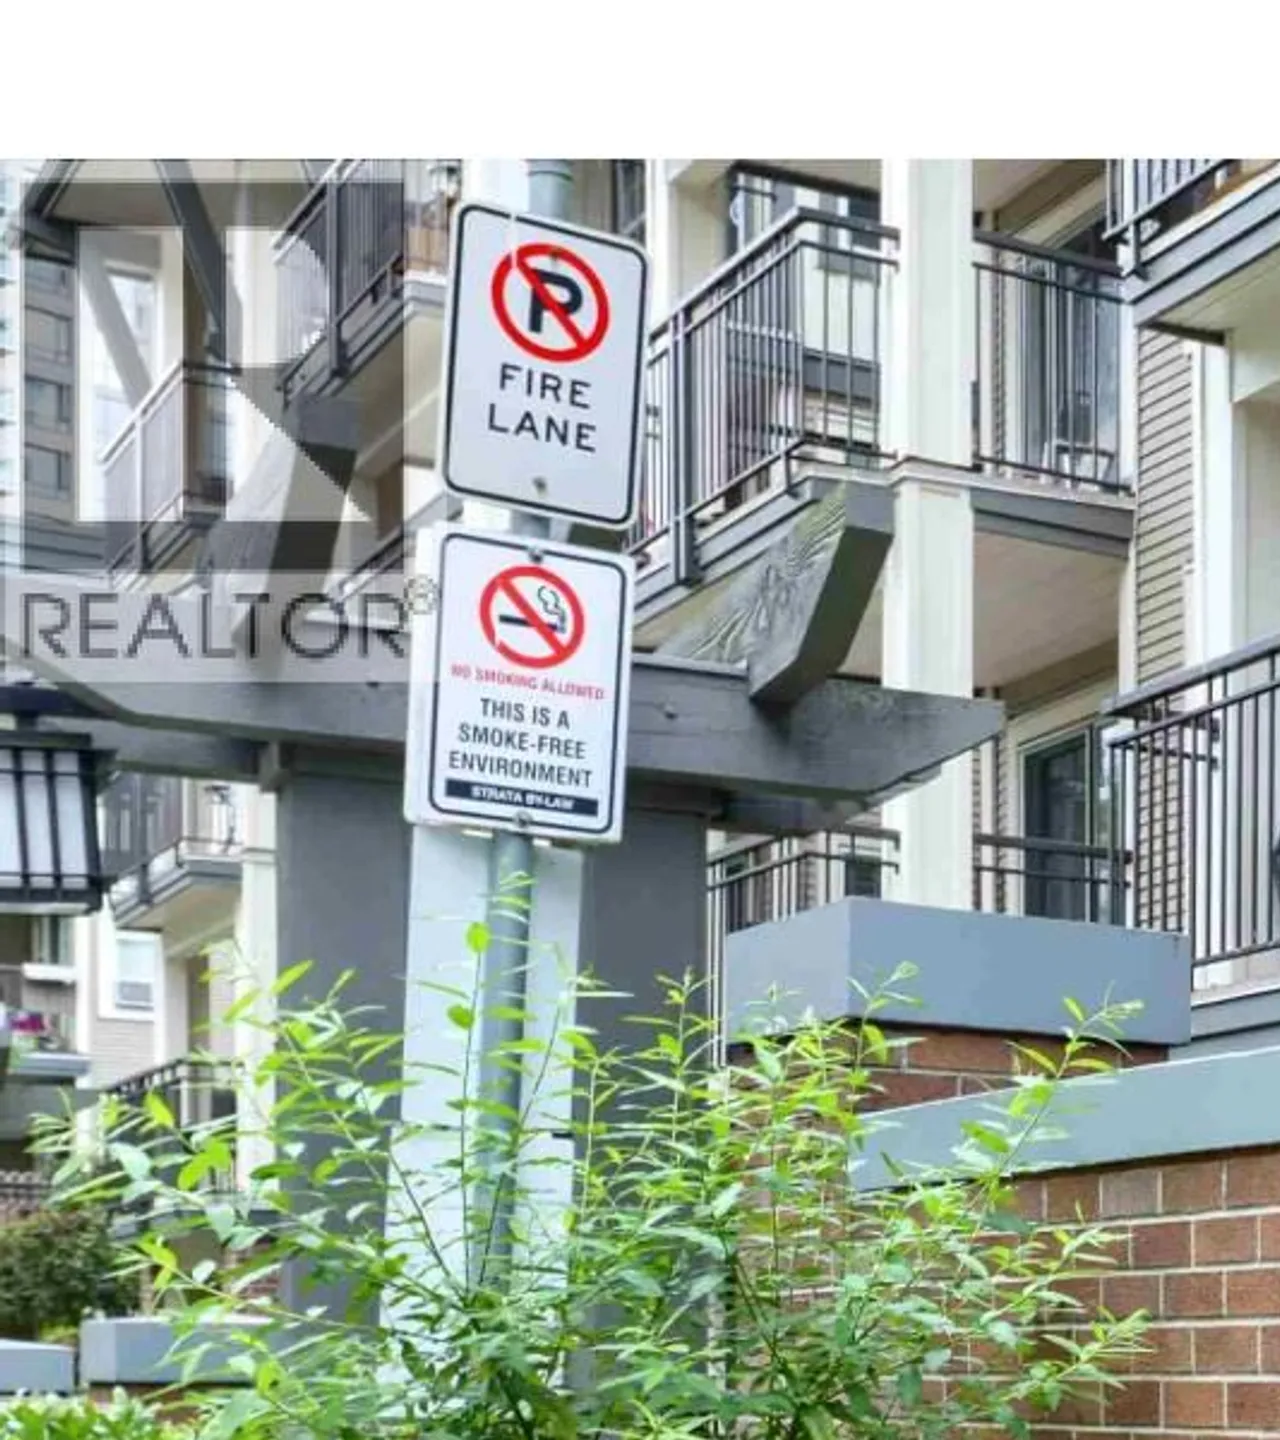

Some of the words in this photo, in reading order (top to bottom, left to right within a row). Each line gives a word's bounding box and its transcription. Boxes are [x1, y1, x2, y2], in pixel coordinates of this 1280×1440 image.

[499, 362, 592, 410] FIRE
[487, 402, 597, 453] LANE
[451, 664, 471, 680] NO
[475, 668, 537, 689] SMOKING
[541, 677, 605, 701] ALLOWED
[481, 697, 525, 724] THIS
[532, 706, 551, 728] IS
[556, 710, 570, 731] A
[458, 722, 587, 760] SMOKE-FREE
[449, 751, 593, 788] ENVIRONMENT
[470, 785, 522, 804] STRATA
[525, 793, 575, 811] BY-LAW
